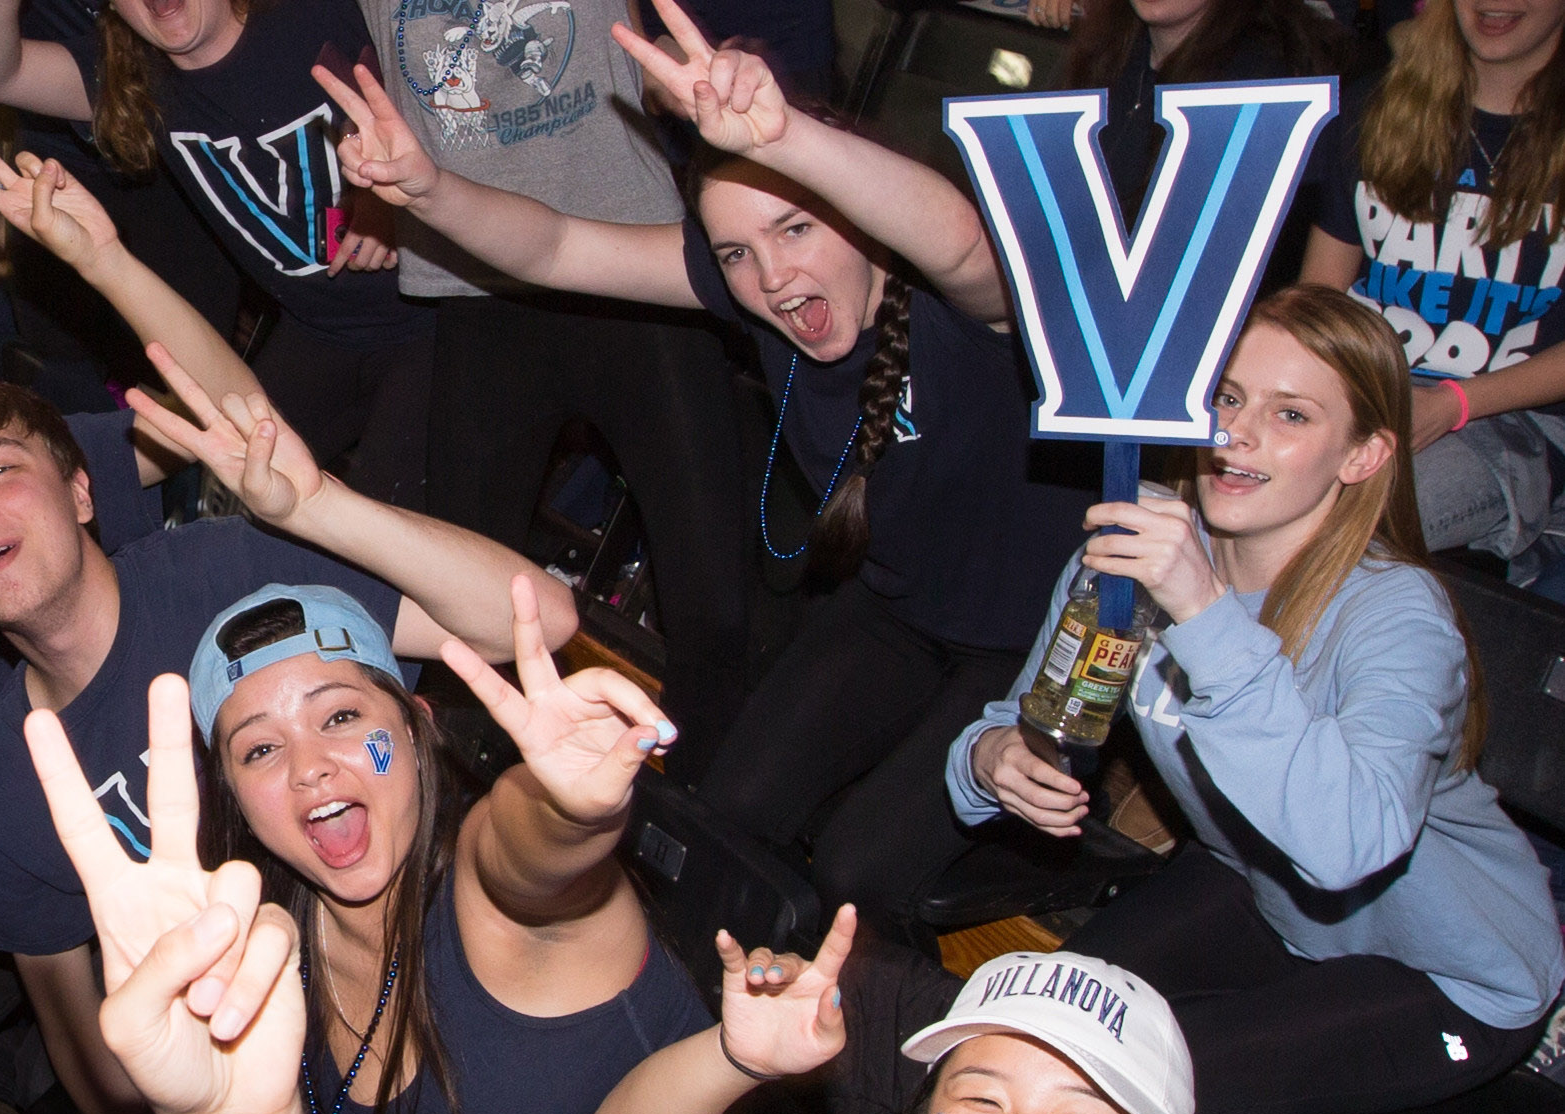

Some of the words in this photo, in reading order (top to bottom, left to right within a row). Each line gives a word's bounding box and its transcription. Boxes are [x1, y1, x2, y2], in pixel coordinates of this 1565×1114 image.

[491, 103, 542, 132] 1985
[544, 80, 597, 117] NCAA
[496, 100, 598, 148] Champions
[170, 103, 341, 277] V
[943, 76, 1340, 449] V
[363, 740, 394, 776] V
[978, 963, 1129, 1045] VILLANOVA
